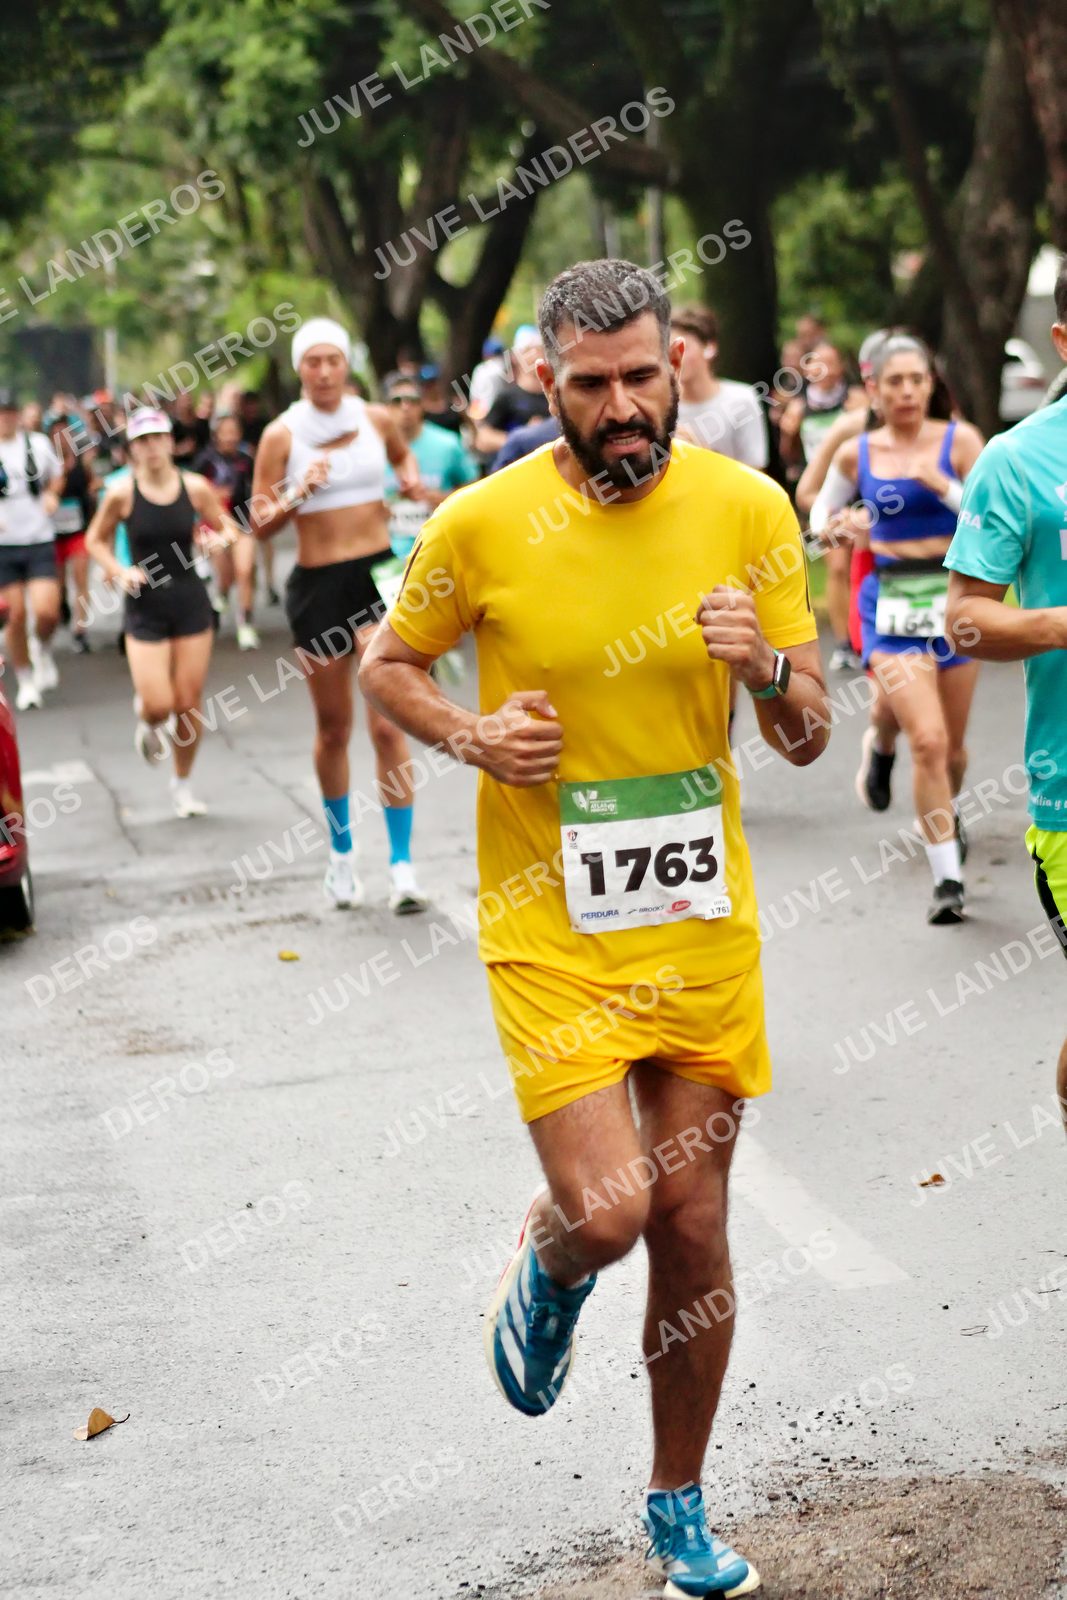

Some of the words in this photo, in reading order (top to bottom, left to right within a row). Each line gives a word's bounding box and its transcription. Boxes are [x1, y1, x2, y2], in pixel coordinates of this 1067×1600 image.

[888, 609, 946, 637] 164
[580, 836, 718, 896] 1763
[580, 909, 620, 920] PERDURA
[638, 904, 665, 913] BROOKS
